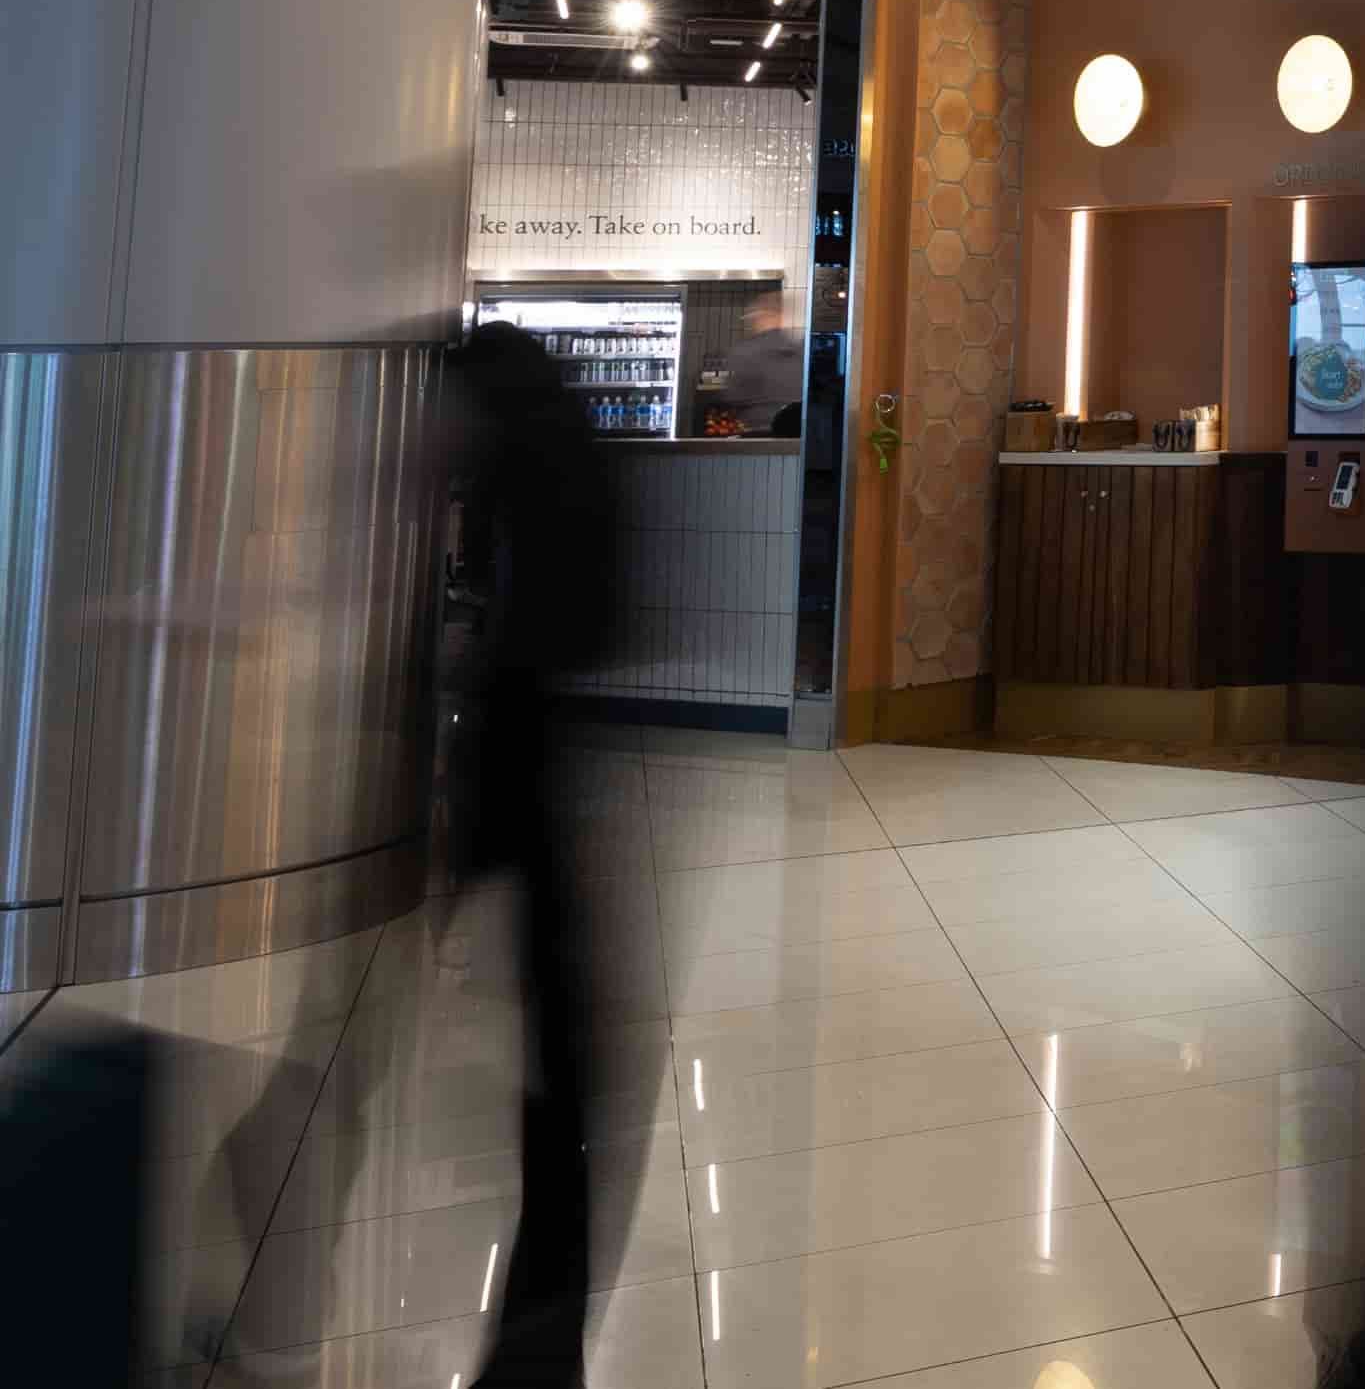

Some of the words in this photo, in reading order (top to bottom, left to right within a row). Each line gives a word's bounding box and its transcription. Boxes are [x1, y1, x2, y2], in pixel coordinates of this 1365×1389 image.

[479, 214, 507, 235] ke
[514, 218, 582, 239] away.
[588, 214, 645, 235] Take
[652, 218, 681, 235] on
[690, 215, 761, 235] board.
